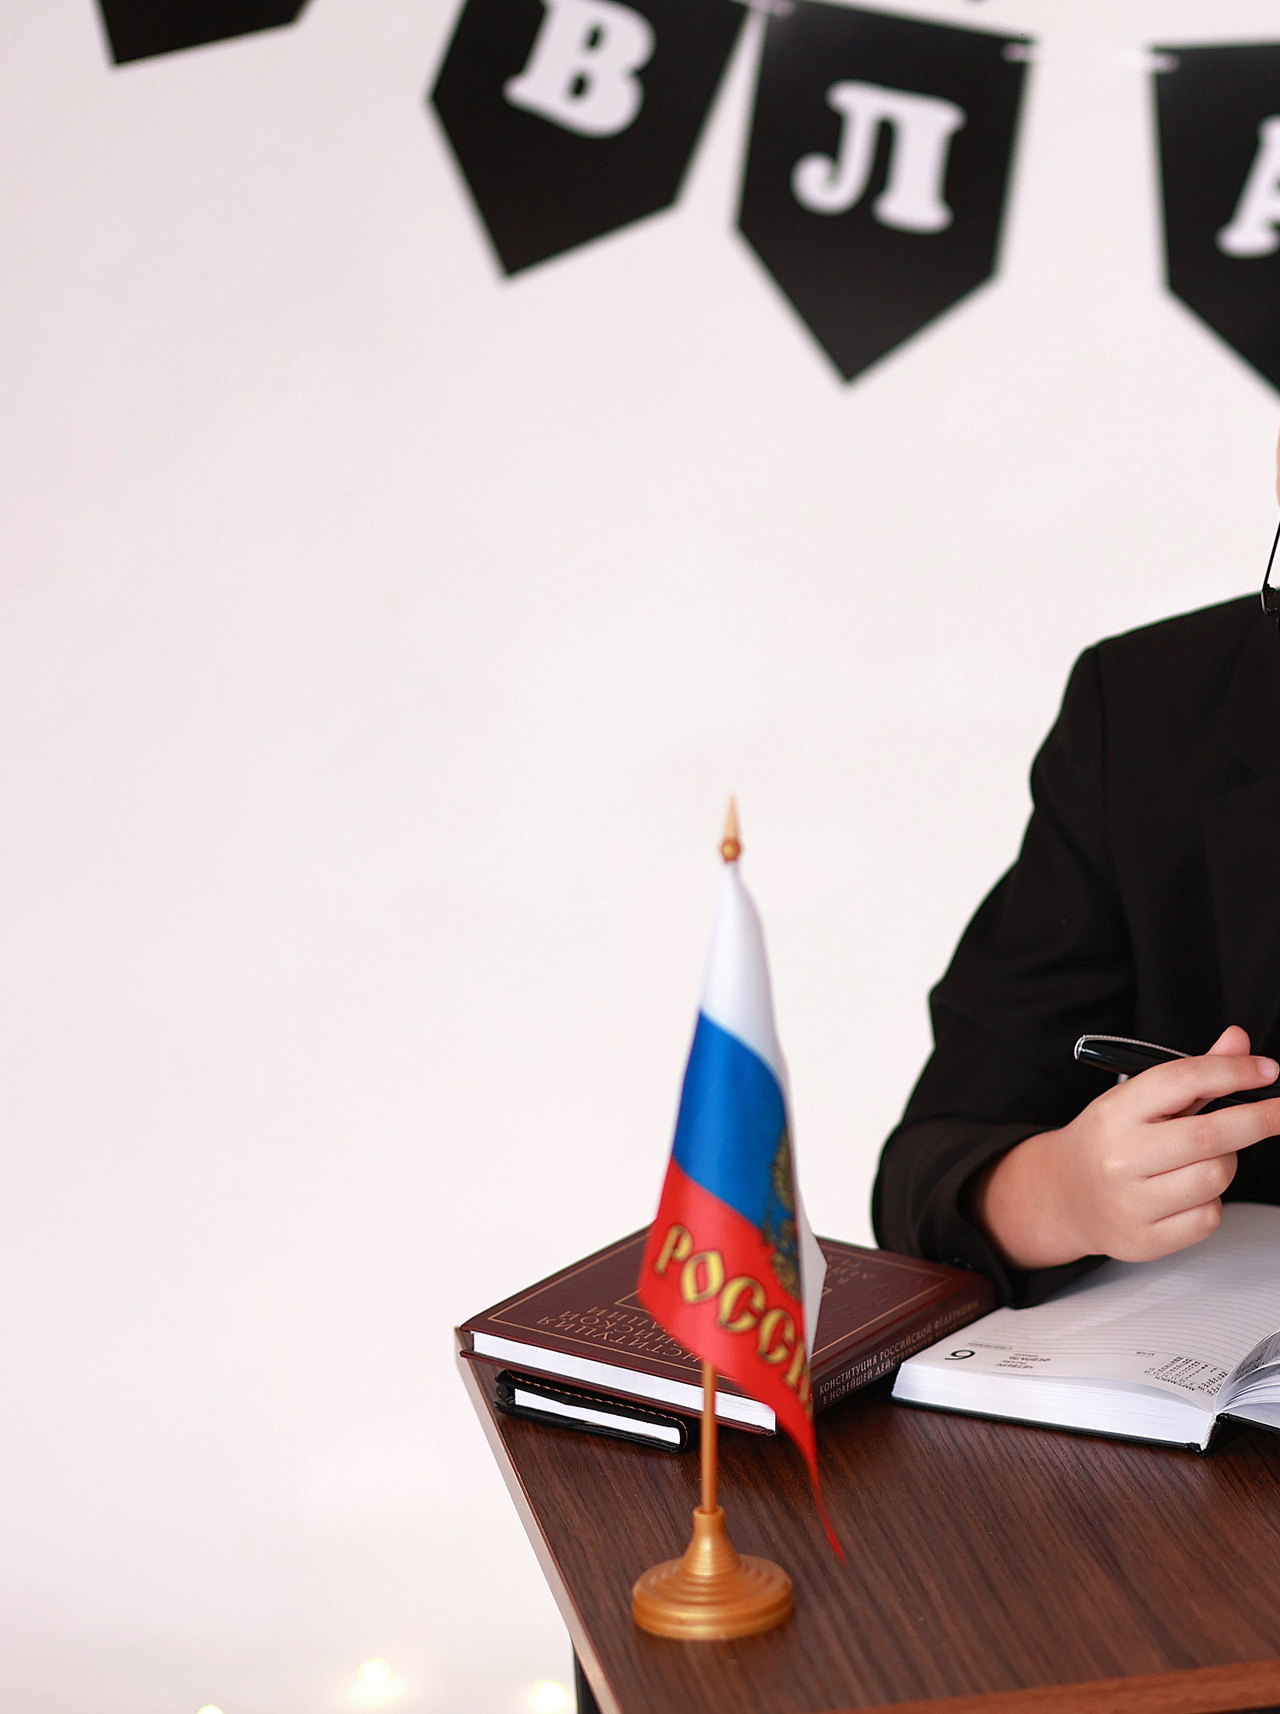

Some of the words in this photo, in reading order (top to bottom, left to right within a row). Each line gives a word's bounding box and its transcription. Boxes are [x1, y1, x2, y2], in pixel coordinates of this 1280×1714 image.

[655, 1225, 811, 1402] РОССИ
[537, 1316, 703, 1362] НСТИТУЦИЯ
[819, 1354, 878, 1395] КОНСТИТУЦИЯ
[879, 1323, 932, 1361] РОССИЙСКОЙ
[944, 1349, 976, 1361] 6
[829, 1370, 873, 1402] НОВЕЙШЕЙ
